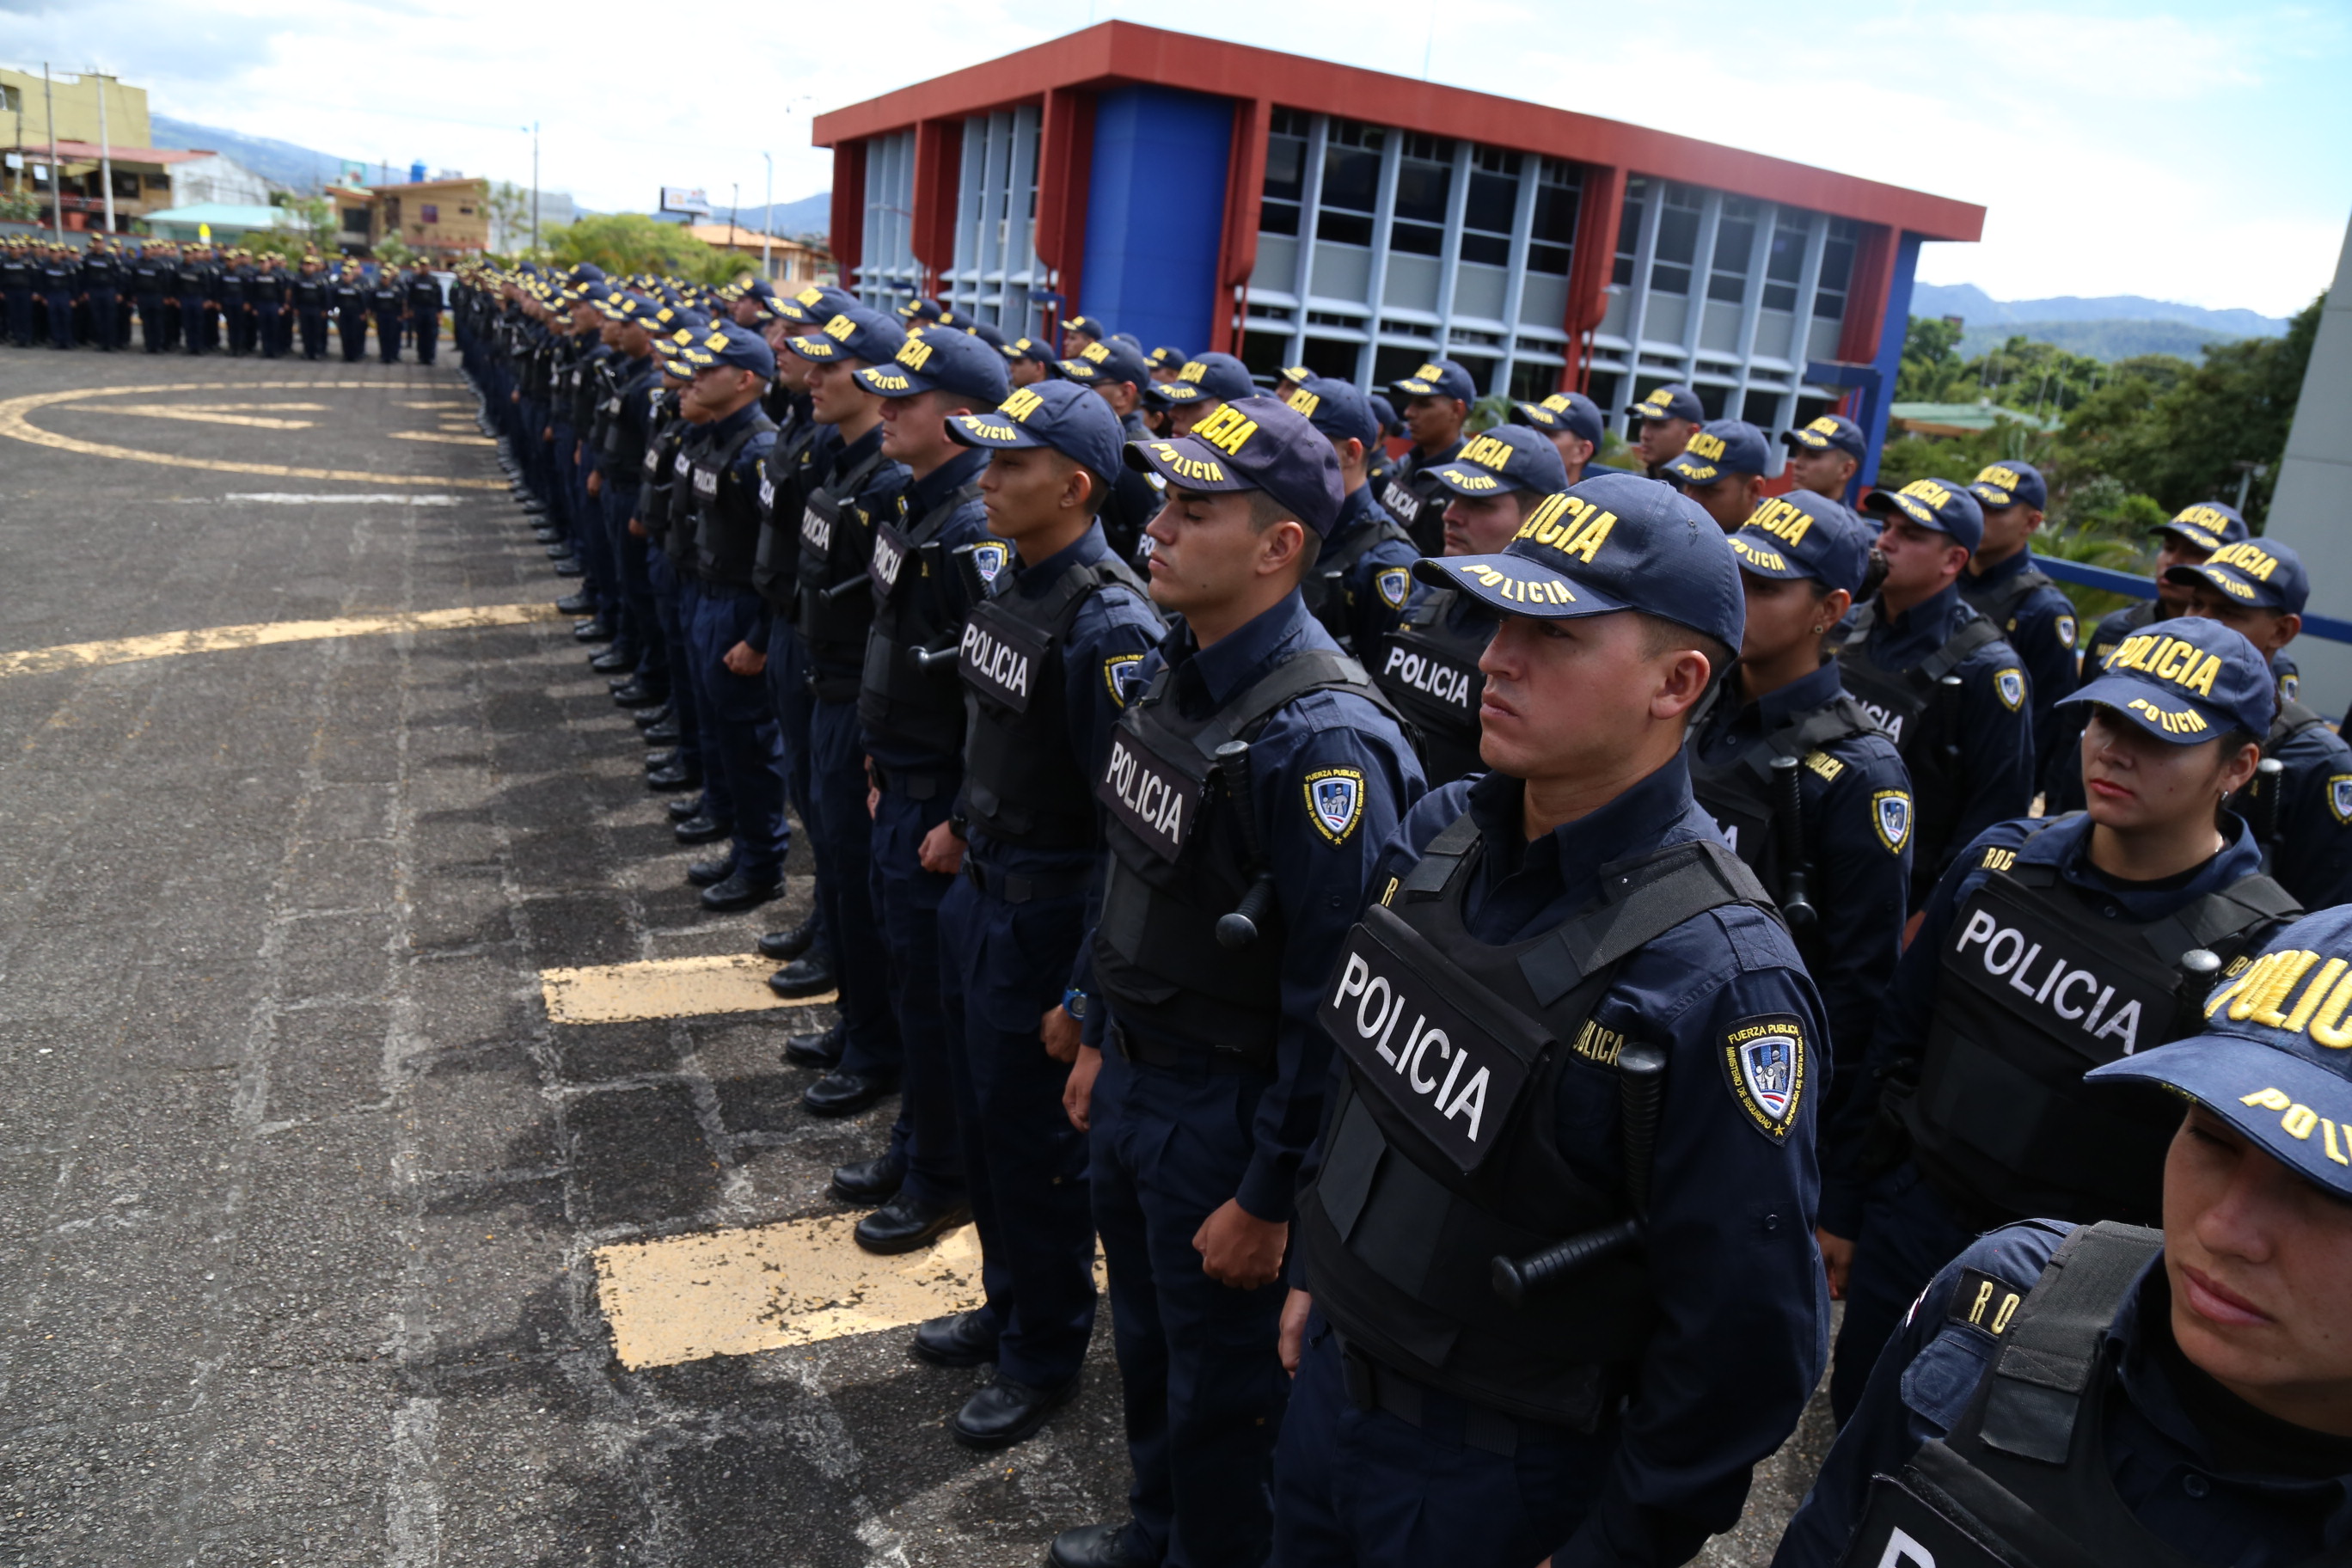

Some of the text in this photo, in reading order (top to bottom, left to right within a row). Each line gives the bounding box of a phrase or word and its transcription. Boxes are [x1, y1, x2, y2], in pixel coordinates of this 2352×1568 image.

[861, 368, 910, 389] POLICIA
[959, 416, 1017, 441] POLICIA
[1149, 443, 1224, 481] POLICIA
[1442, 469, 1498, 490] POLICIA
[1460, 564, 1577, 605] POLICIA
[959, 622, 1028, 697] POLICIA
[1383, 646, 1470, 708] POLICIA
[2104, 635, 2222, 697] POLICIA
[2127, 698, 2208, 734] POLICIA
[1105, 741, 1183, 844] POLICIA
[1956, 909, 2142, 1056] POLICIA
[1333, 951, 1491, 1143] POLICIA
[1728, 1024, 1799, 1044] FUERZA PUBLICA
[1726, 1046, 1773, 1130] MINISTERIO DE SEGURIDAD
